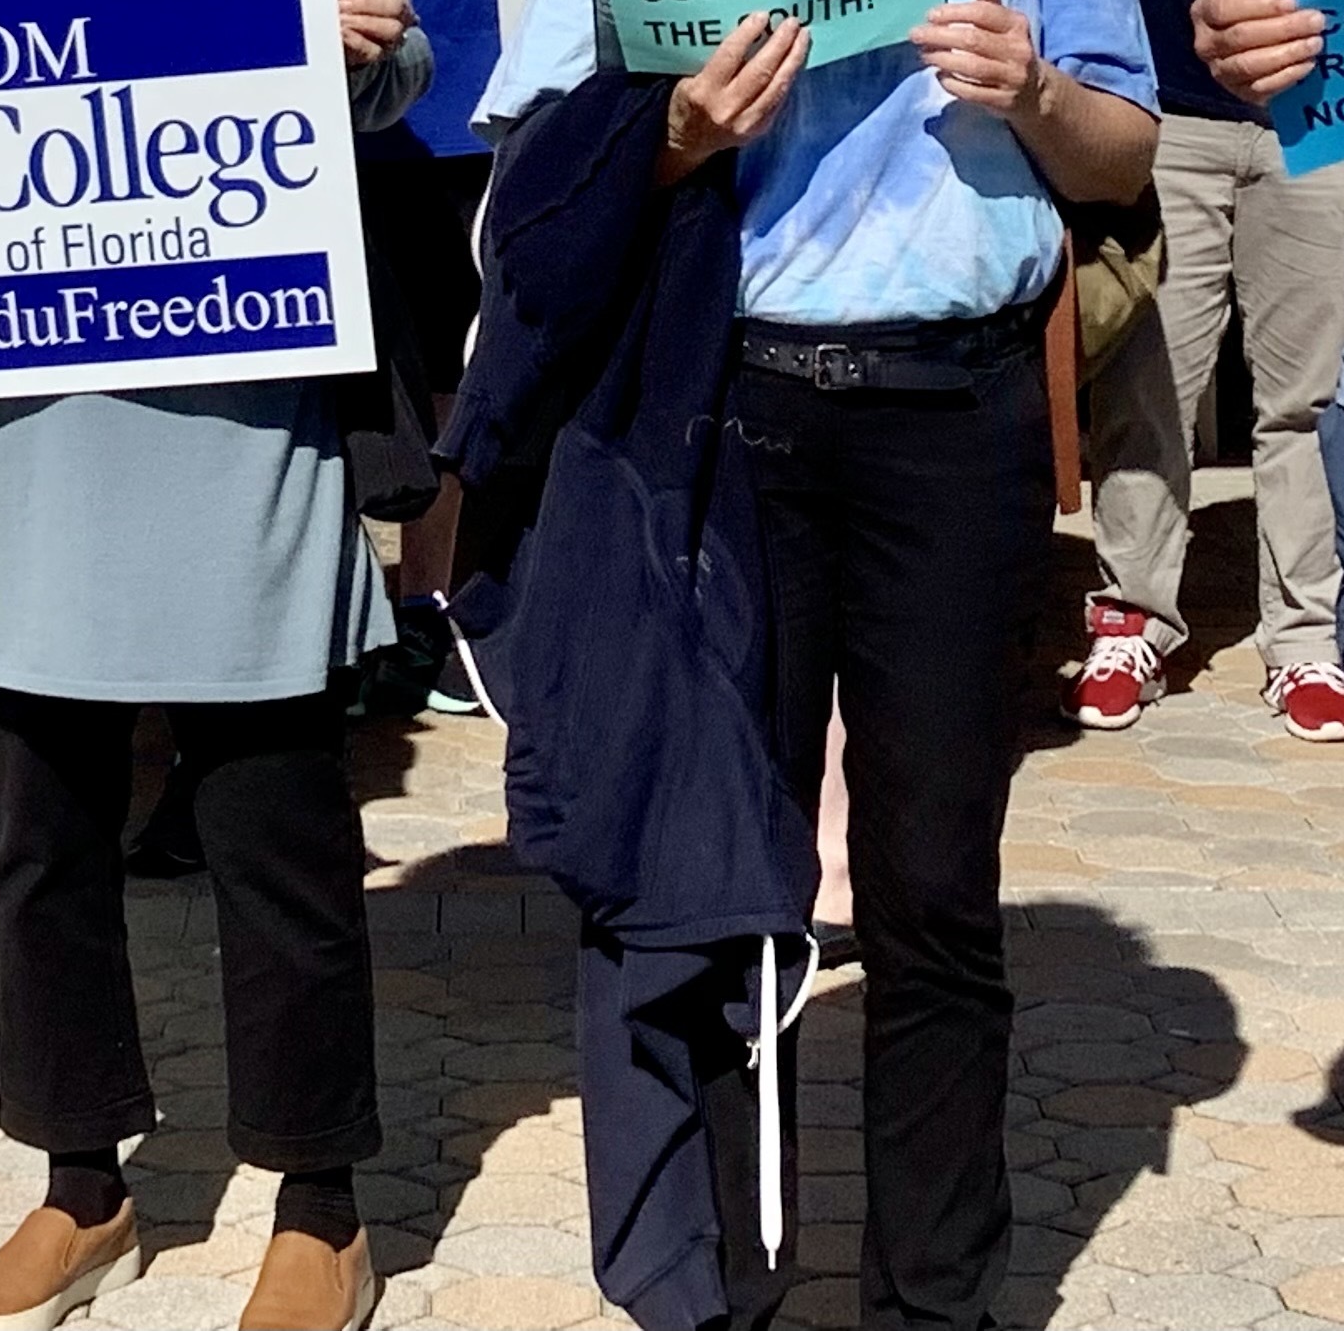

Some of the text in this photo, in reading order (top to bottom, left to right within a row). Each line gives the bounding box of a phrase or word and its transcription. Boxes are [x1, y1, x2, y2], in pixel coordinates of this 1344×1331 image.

[643, 19, 721, 46] THE
[6, 218, 211, 272] of Florida
